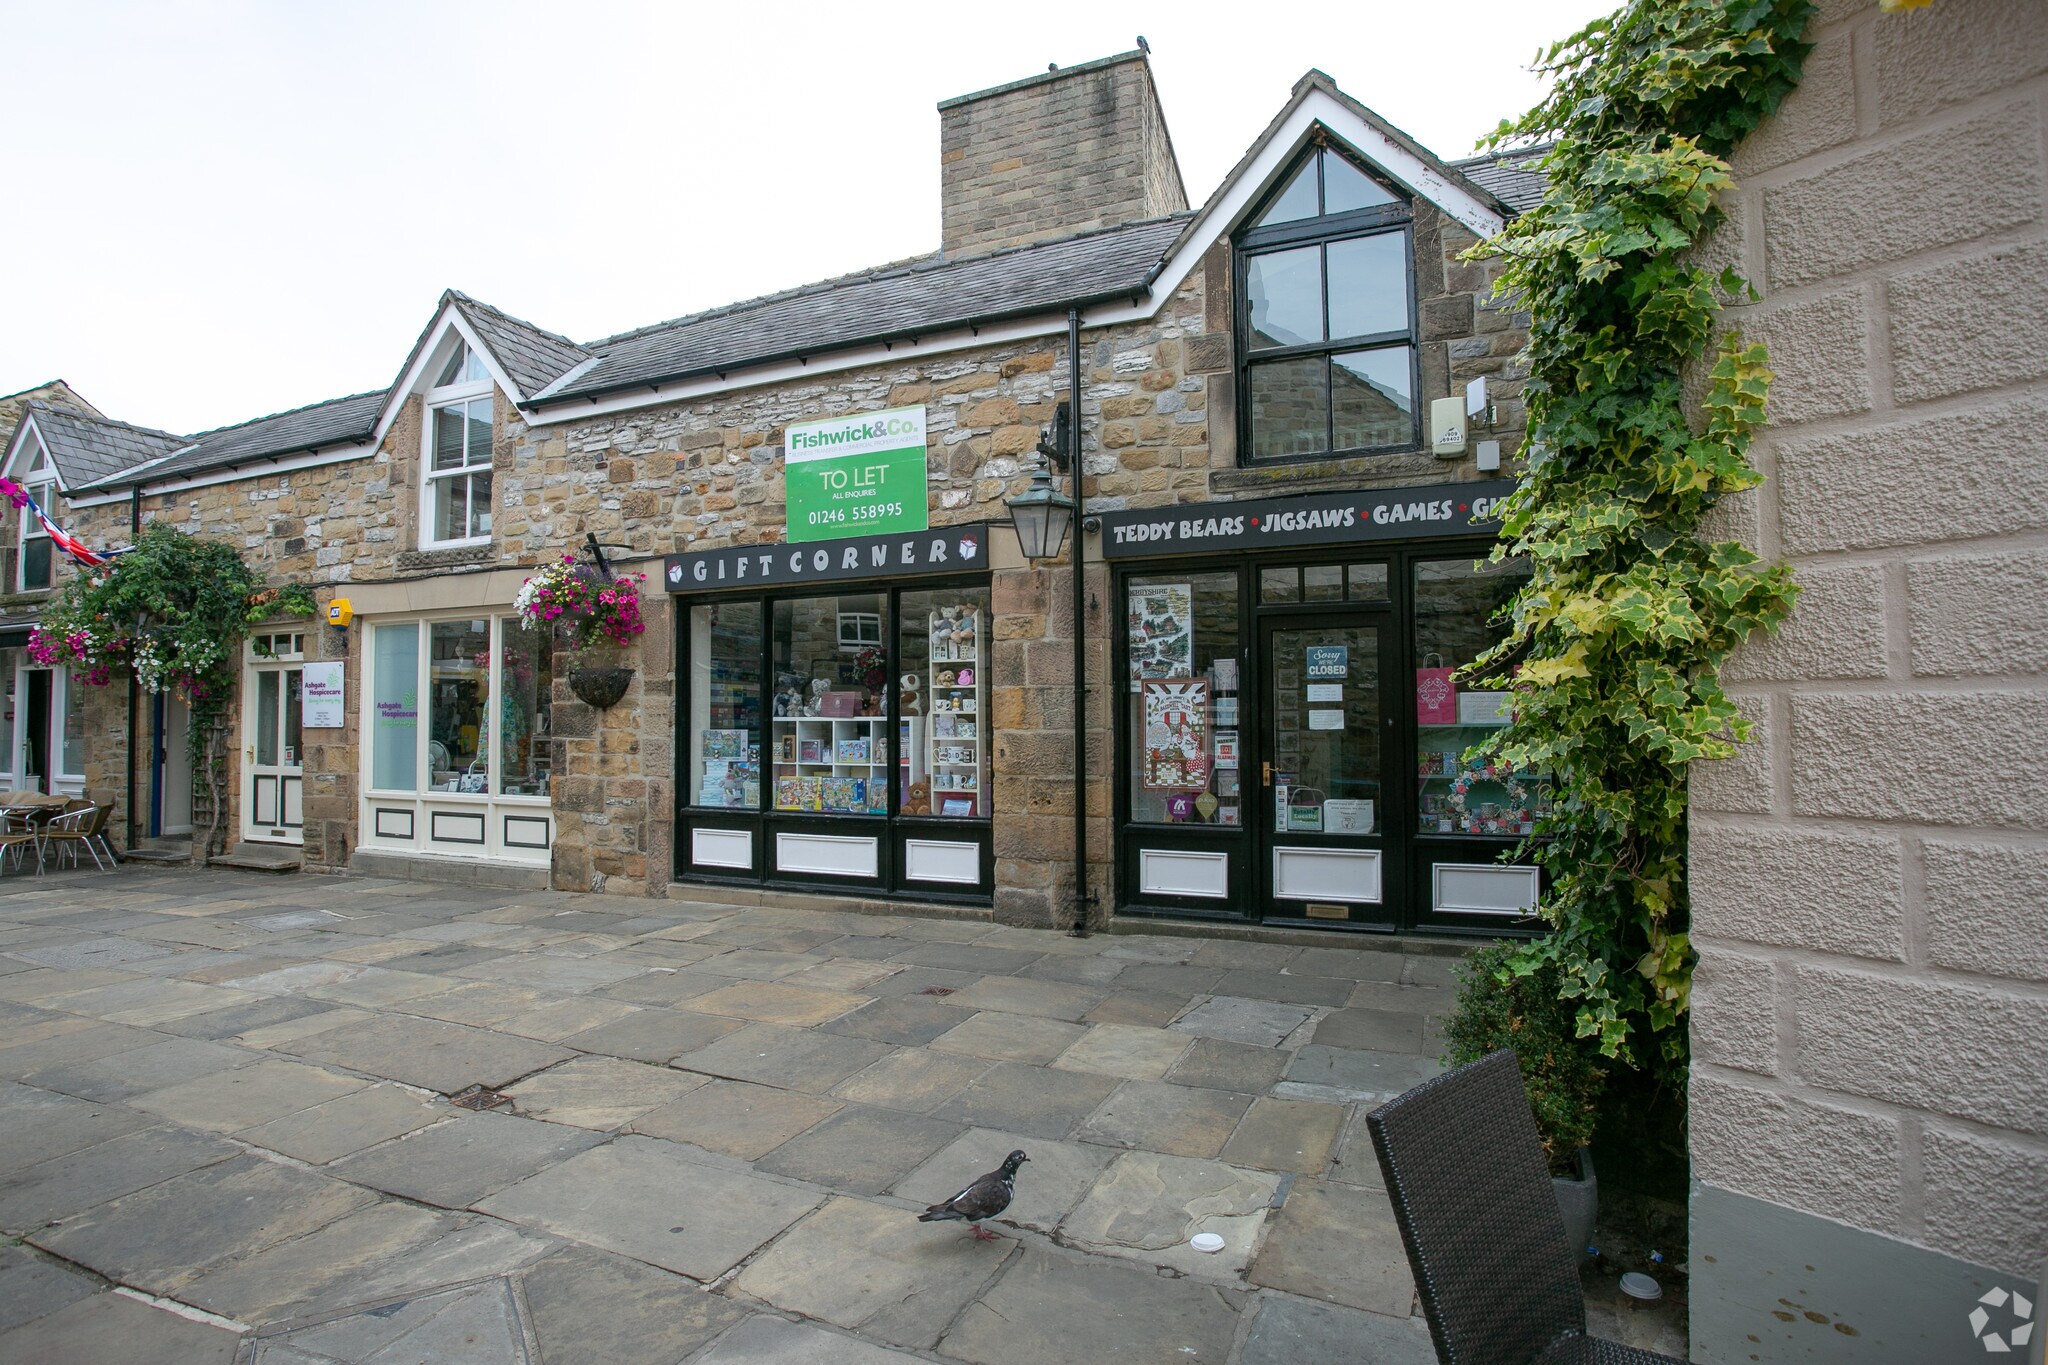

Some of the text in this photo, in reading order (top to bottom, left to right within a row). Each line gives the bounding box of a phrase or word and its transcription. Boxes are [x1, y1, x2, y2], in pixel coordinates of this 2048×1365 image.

[791, 418, 918, 450] Fishwick&Co.
[819, 464, 890, 490] TO LET
[832, 488, 877, 500] ALL ENQUIRIES
[808, 502, 903, 525] 01246 558995
[1113, 521, 1175, 544] TEDDY
[1179, 515, 1244, 539] BEARS
[1260, 507, 1355, 533] JIGSAWS
[1372, 499, 1453, 525] GAMES
[693, 538, 947, 582] GIFT CORNER
[330, 608, 340, 617] ADT
[1313, 649, 1341, 662] Sorry
[1308, 664, 1346, 675] CLOSED
[304, 682, 326, 690] Ashgate
[376, 702, 402, 711] Ashgate
